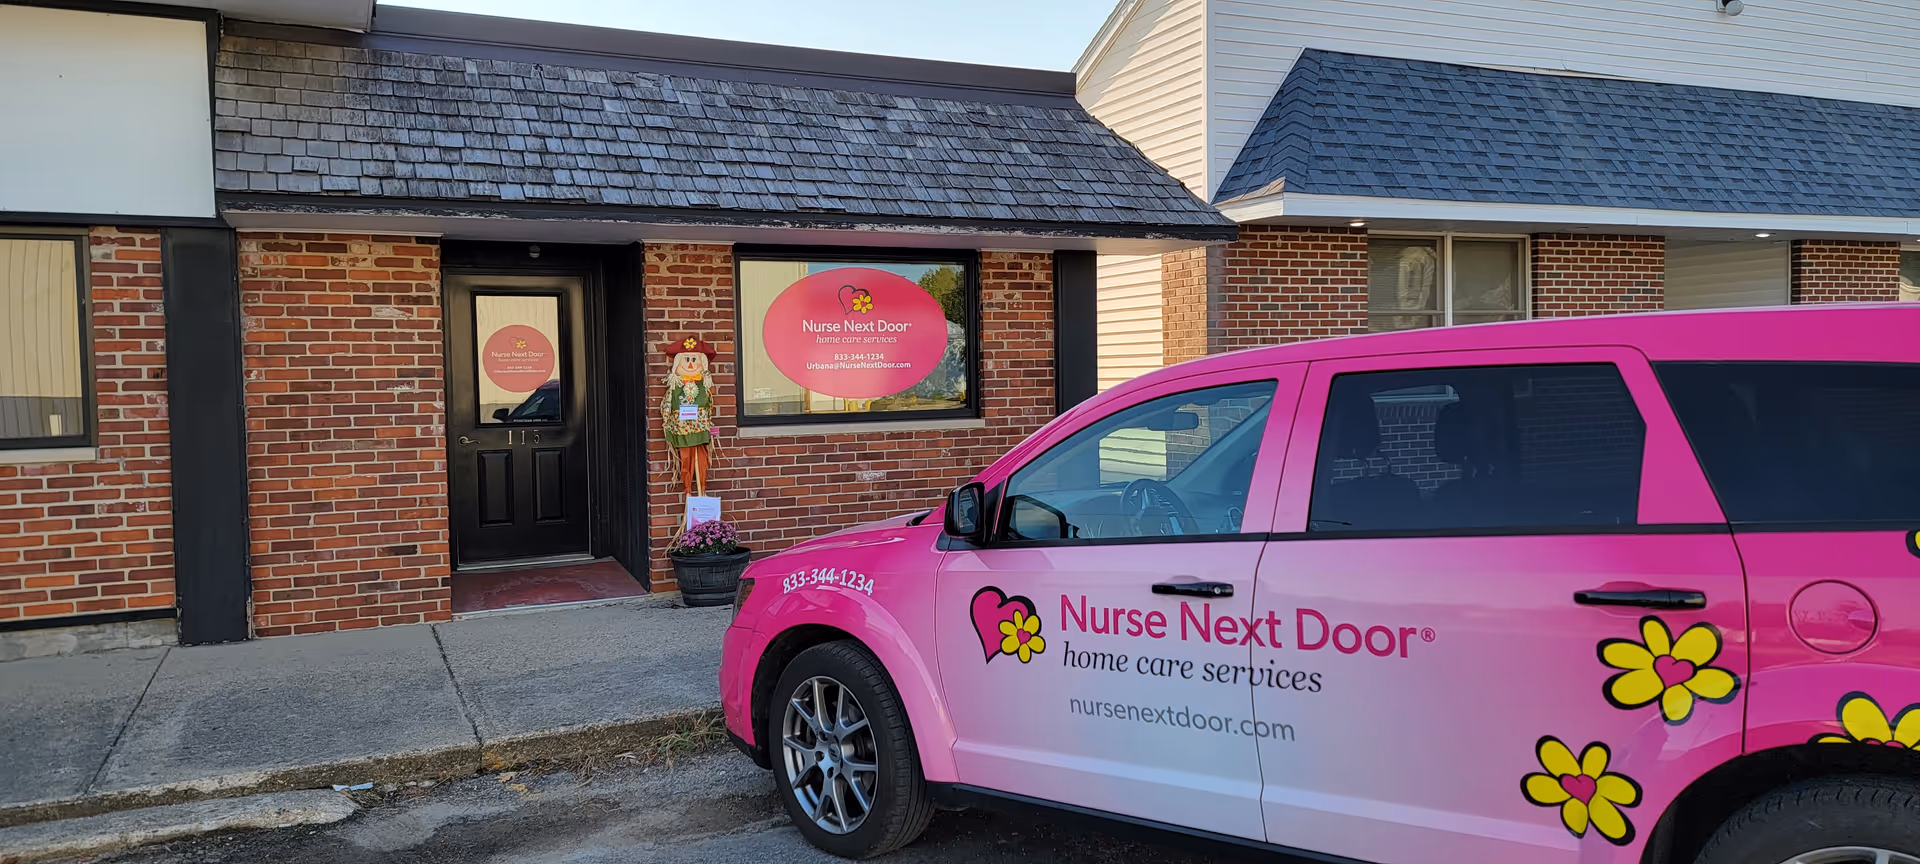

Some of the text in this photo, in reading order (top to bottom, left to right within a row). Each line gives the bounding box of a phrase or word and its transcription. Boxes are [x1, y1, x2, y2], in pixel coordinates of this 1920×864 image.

[802, 319, 841, 333] Nurse
[844, 319, 875, 333] Next
[816, 334, 898, 344] home care services
[834, 353, 885, 361] 833-344-1234
[806, 361, 912, 371] Urbana@NurseNextDoor.com
[508, 429, 540, 445] 115
[782, 567, 875, 596] 833-344-1234
[1060, 594, 1168, 639] Nurse
[1180, 601, 1283, 649] Next
[1063, 641, 1322, 693] home care services
[1069, 696, 1296, 742] nursenextdoor.com
